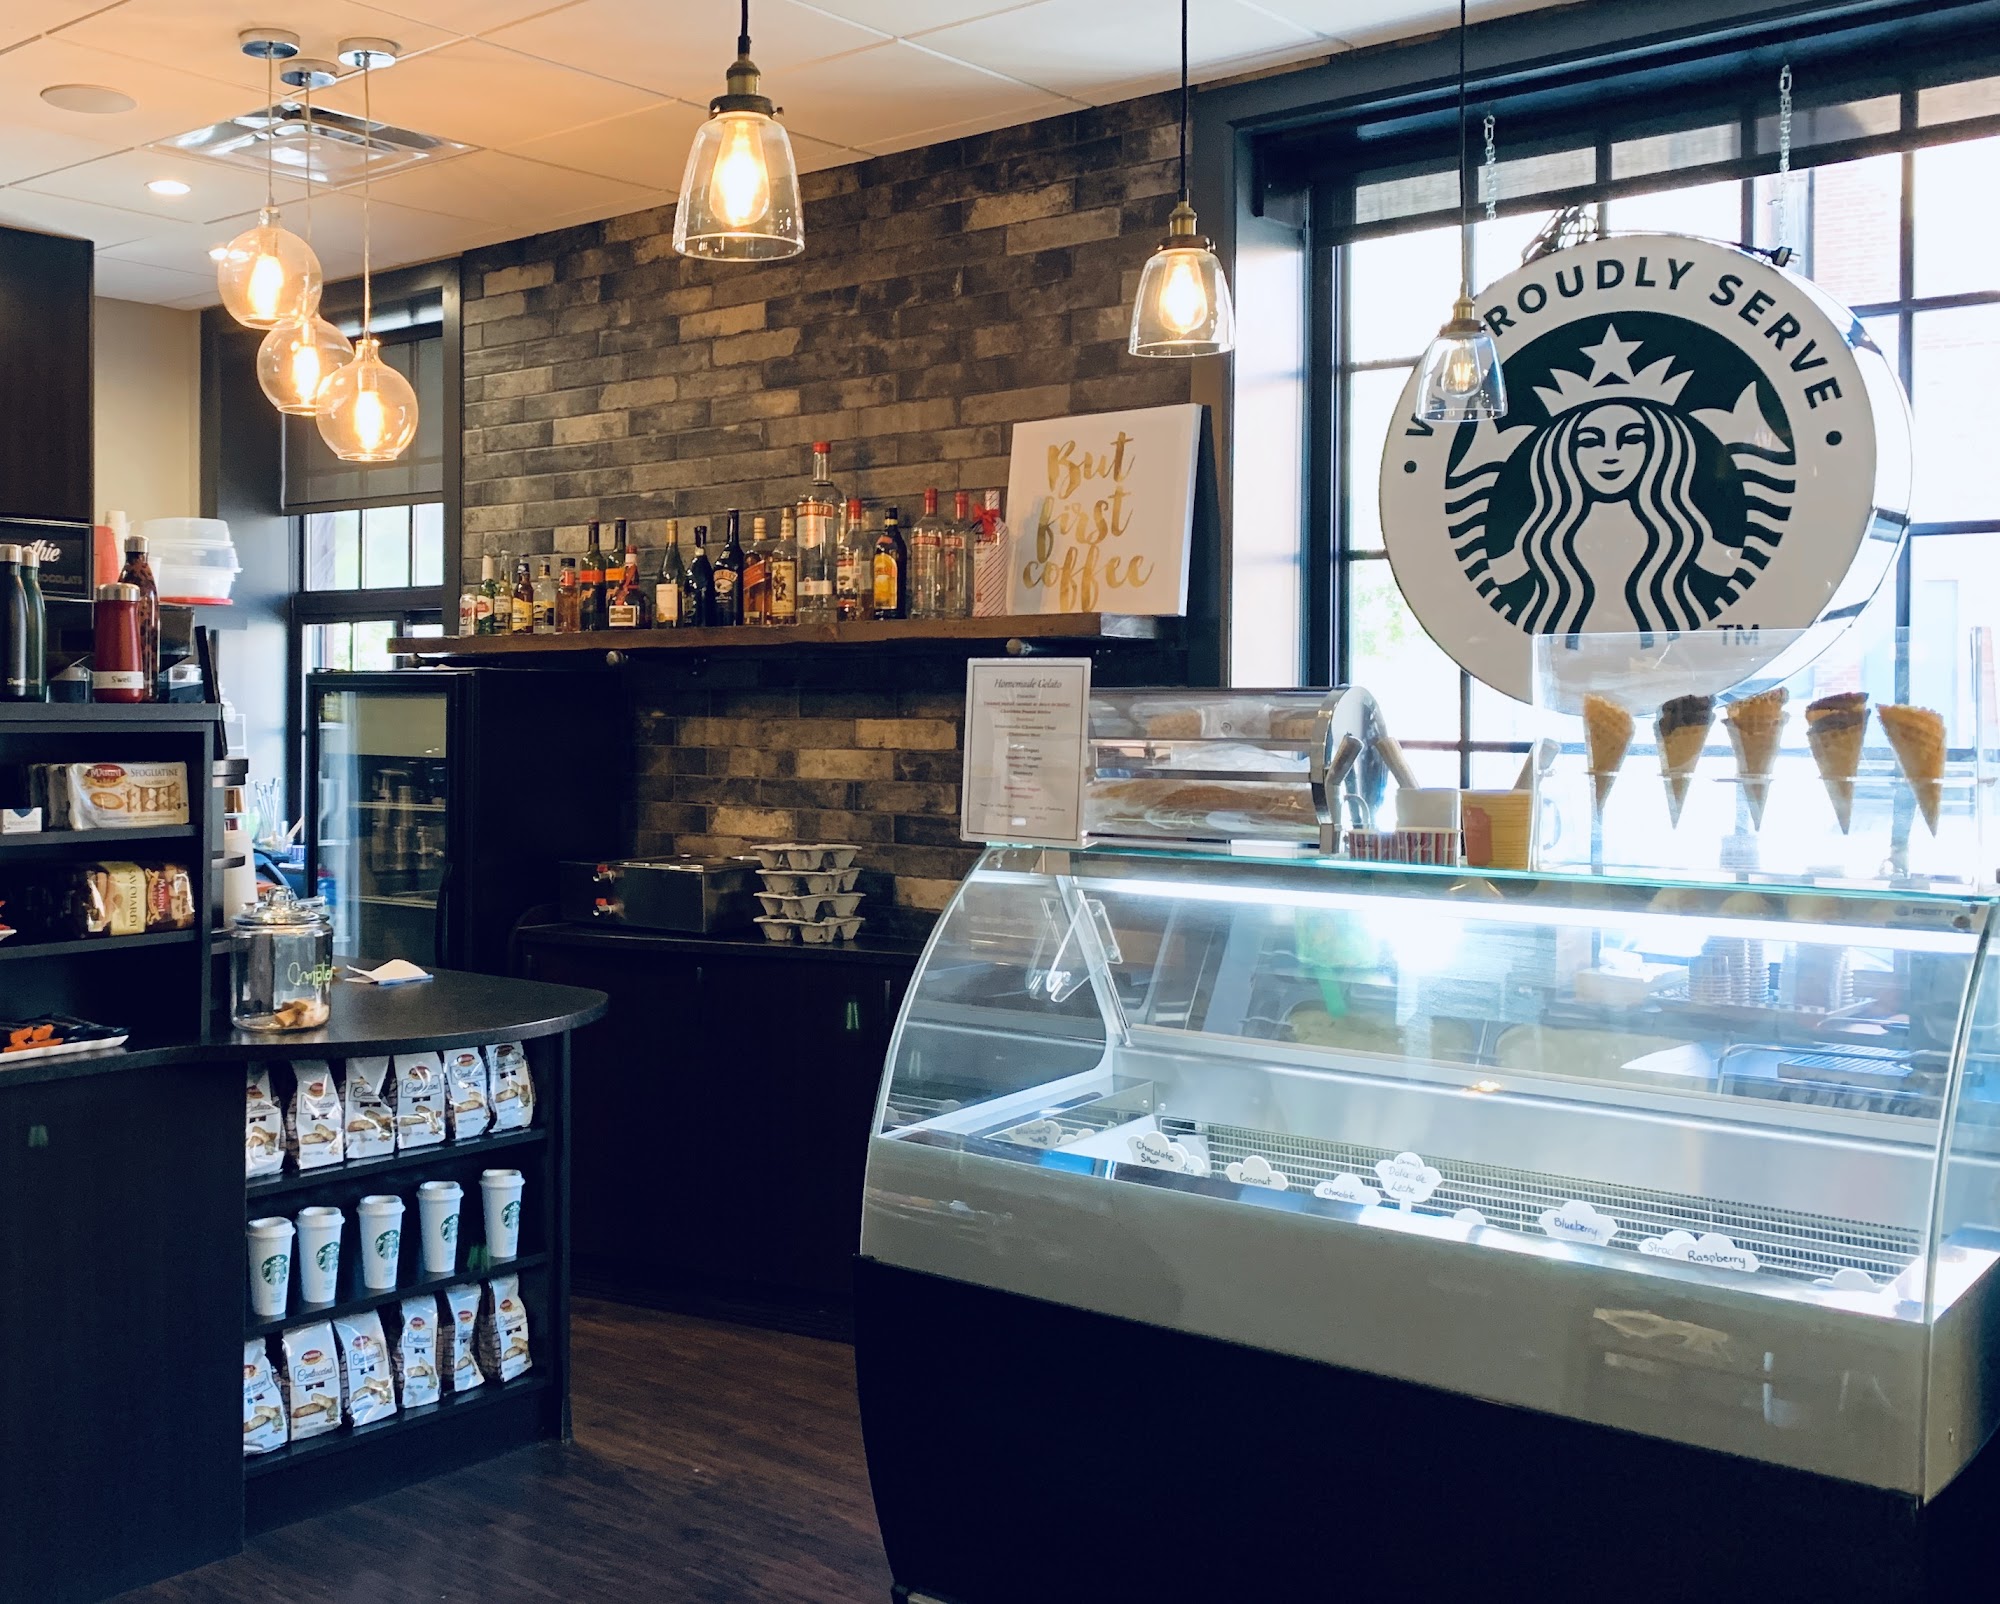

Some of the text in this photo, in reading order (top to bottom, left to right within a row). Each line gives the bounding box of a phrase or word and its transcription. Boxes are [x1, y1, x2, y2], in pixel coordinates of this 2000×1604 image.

[1483, 257, 1695, 338] ROUDLY
[1709, 274, 1843, 410] SERVE
[1047, 431, 1136, 500] But
[1036, 486, 1134, 564] first
[1023, 543, 1155, 613] coffee
[1717, 624, 1759, 645] TM
[994, 678, 1062, 689] Homemade Gelato
[1136, 1141, 1175, 1163] Chocolate
[1239, 1171, 1272, 1186] Coconut
[1553, 1216, 1598, 1239] Blueberry
[1687, 1250, 1747, 1269] Raspberry
